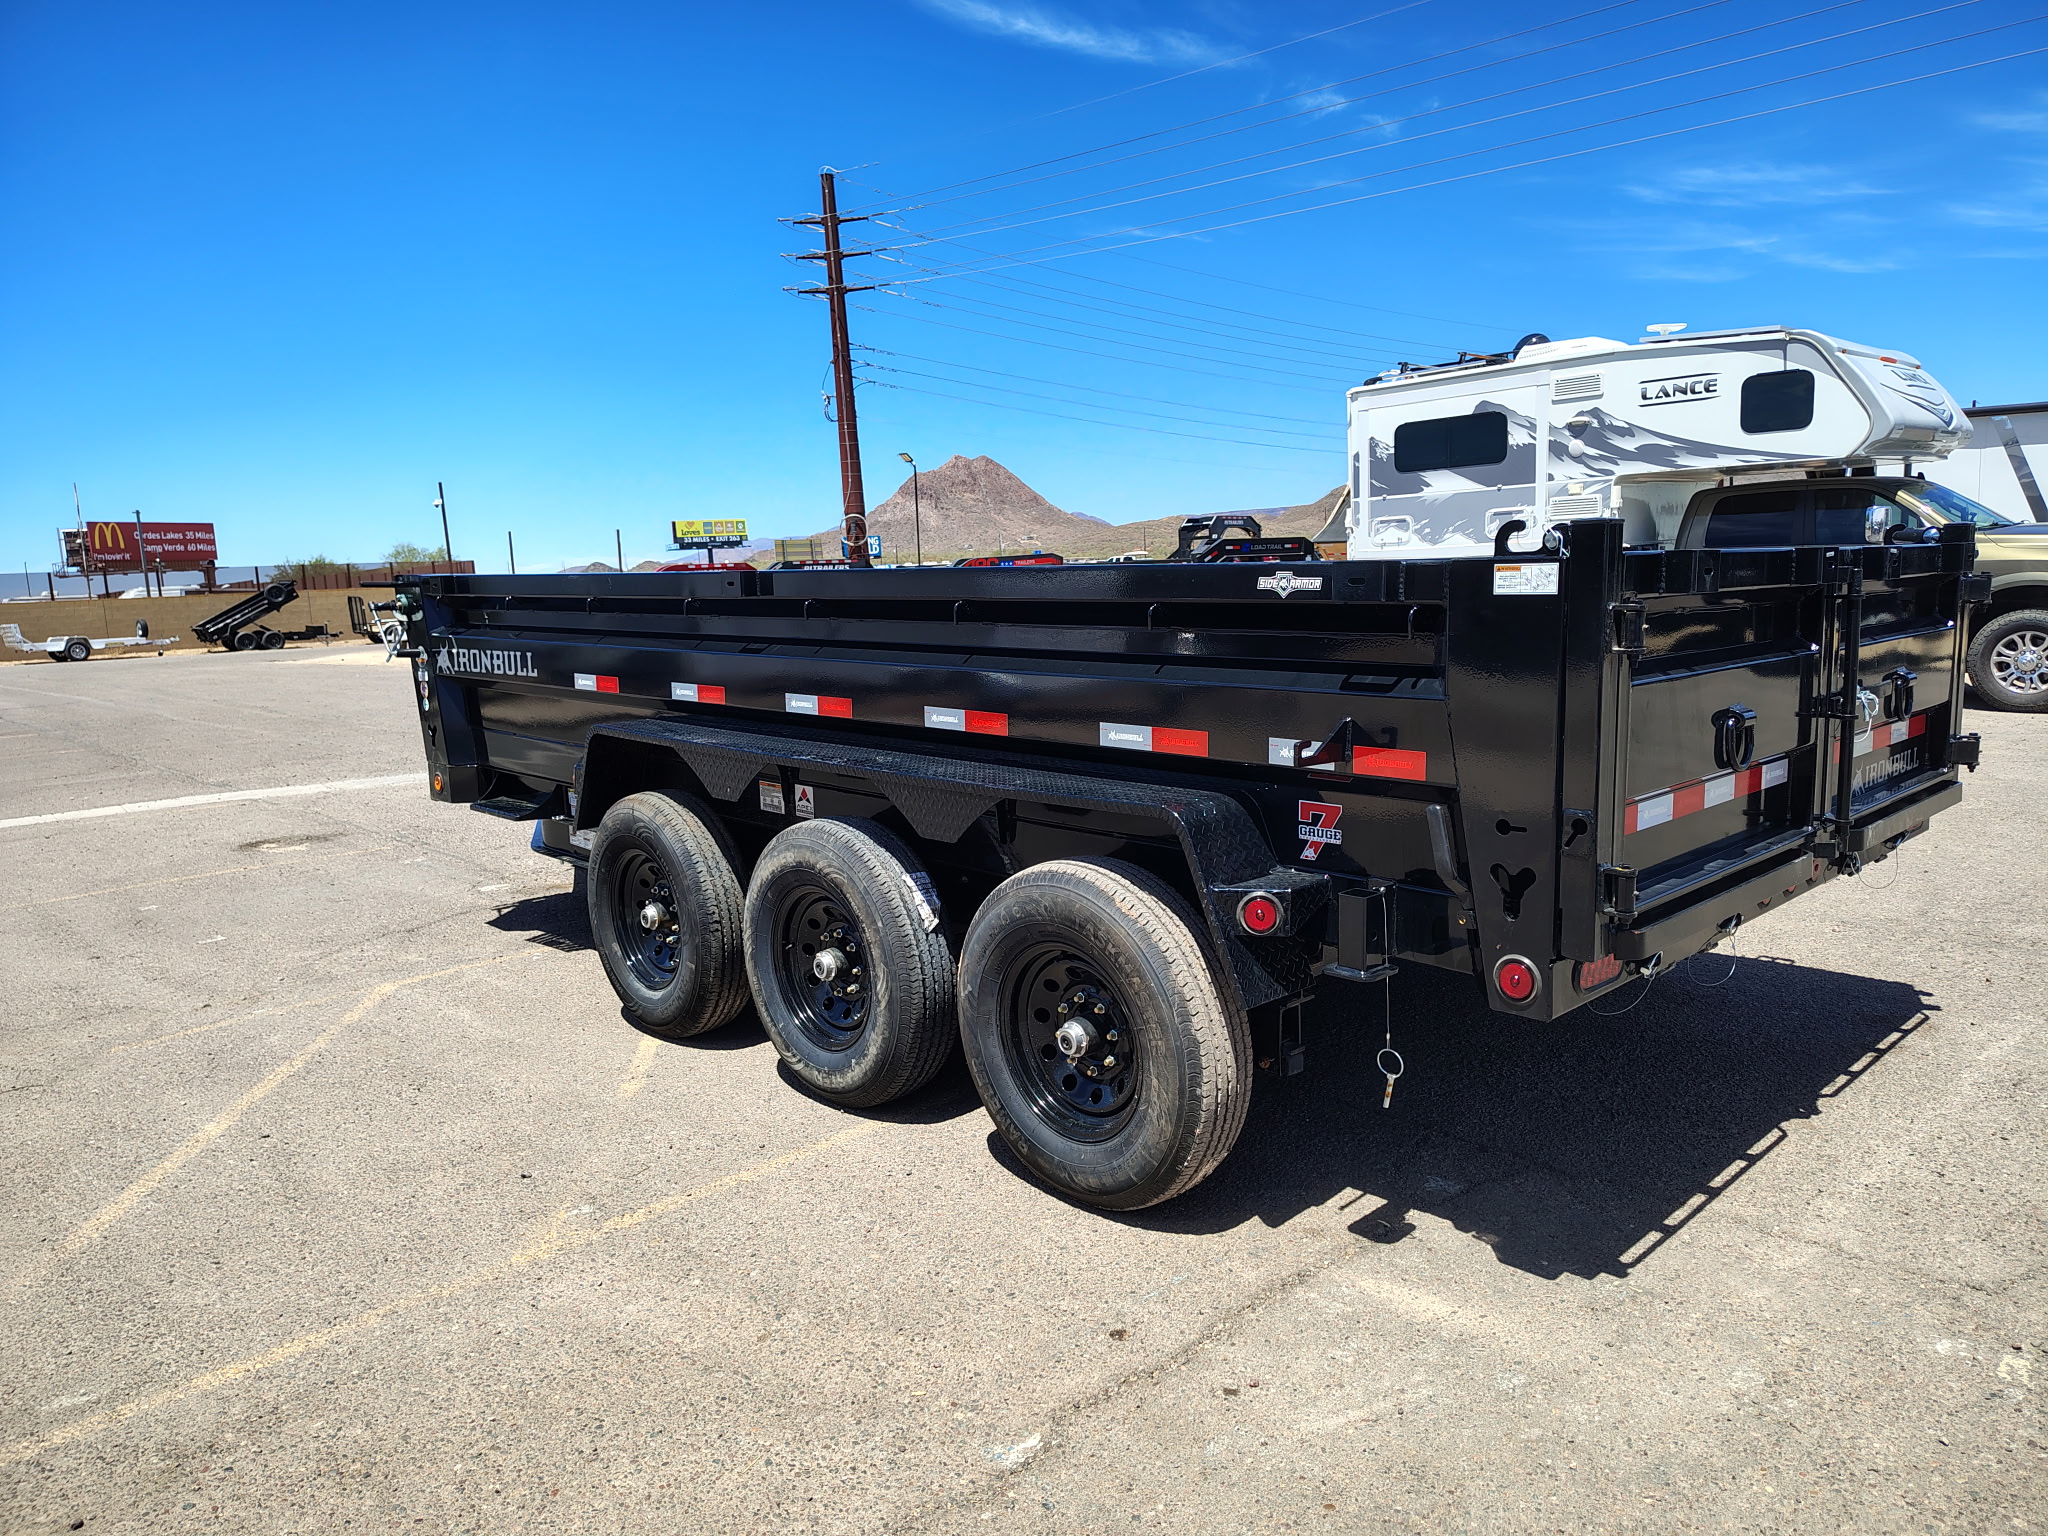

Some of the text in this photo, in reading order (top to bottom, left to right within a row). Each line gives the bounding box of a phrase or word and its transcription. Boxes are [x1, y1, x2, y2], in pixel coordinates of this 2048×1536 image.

[1640, 378, 1718, 401] LANCE
[133, 531, 215, 540] Crdes Lakes 35 Miles
[163, 543, 185, 551] Verde
[187, 543, 196, 551] 60
[197, 543, 216, 552] Miles
[93, 552, 105, 561] I'm
[1259, 579, 1321, 589] SIDE ARMOR
[453, 648, 538, 677] IRONBULL
[1864, 746, 1920, 789] IRONBULL
[1299, 826, 1341, 841] GAUGE
